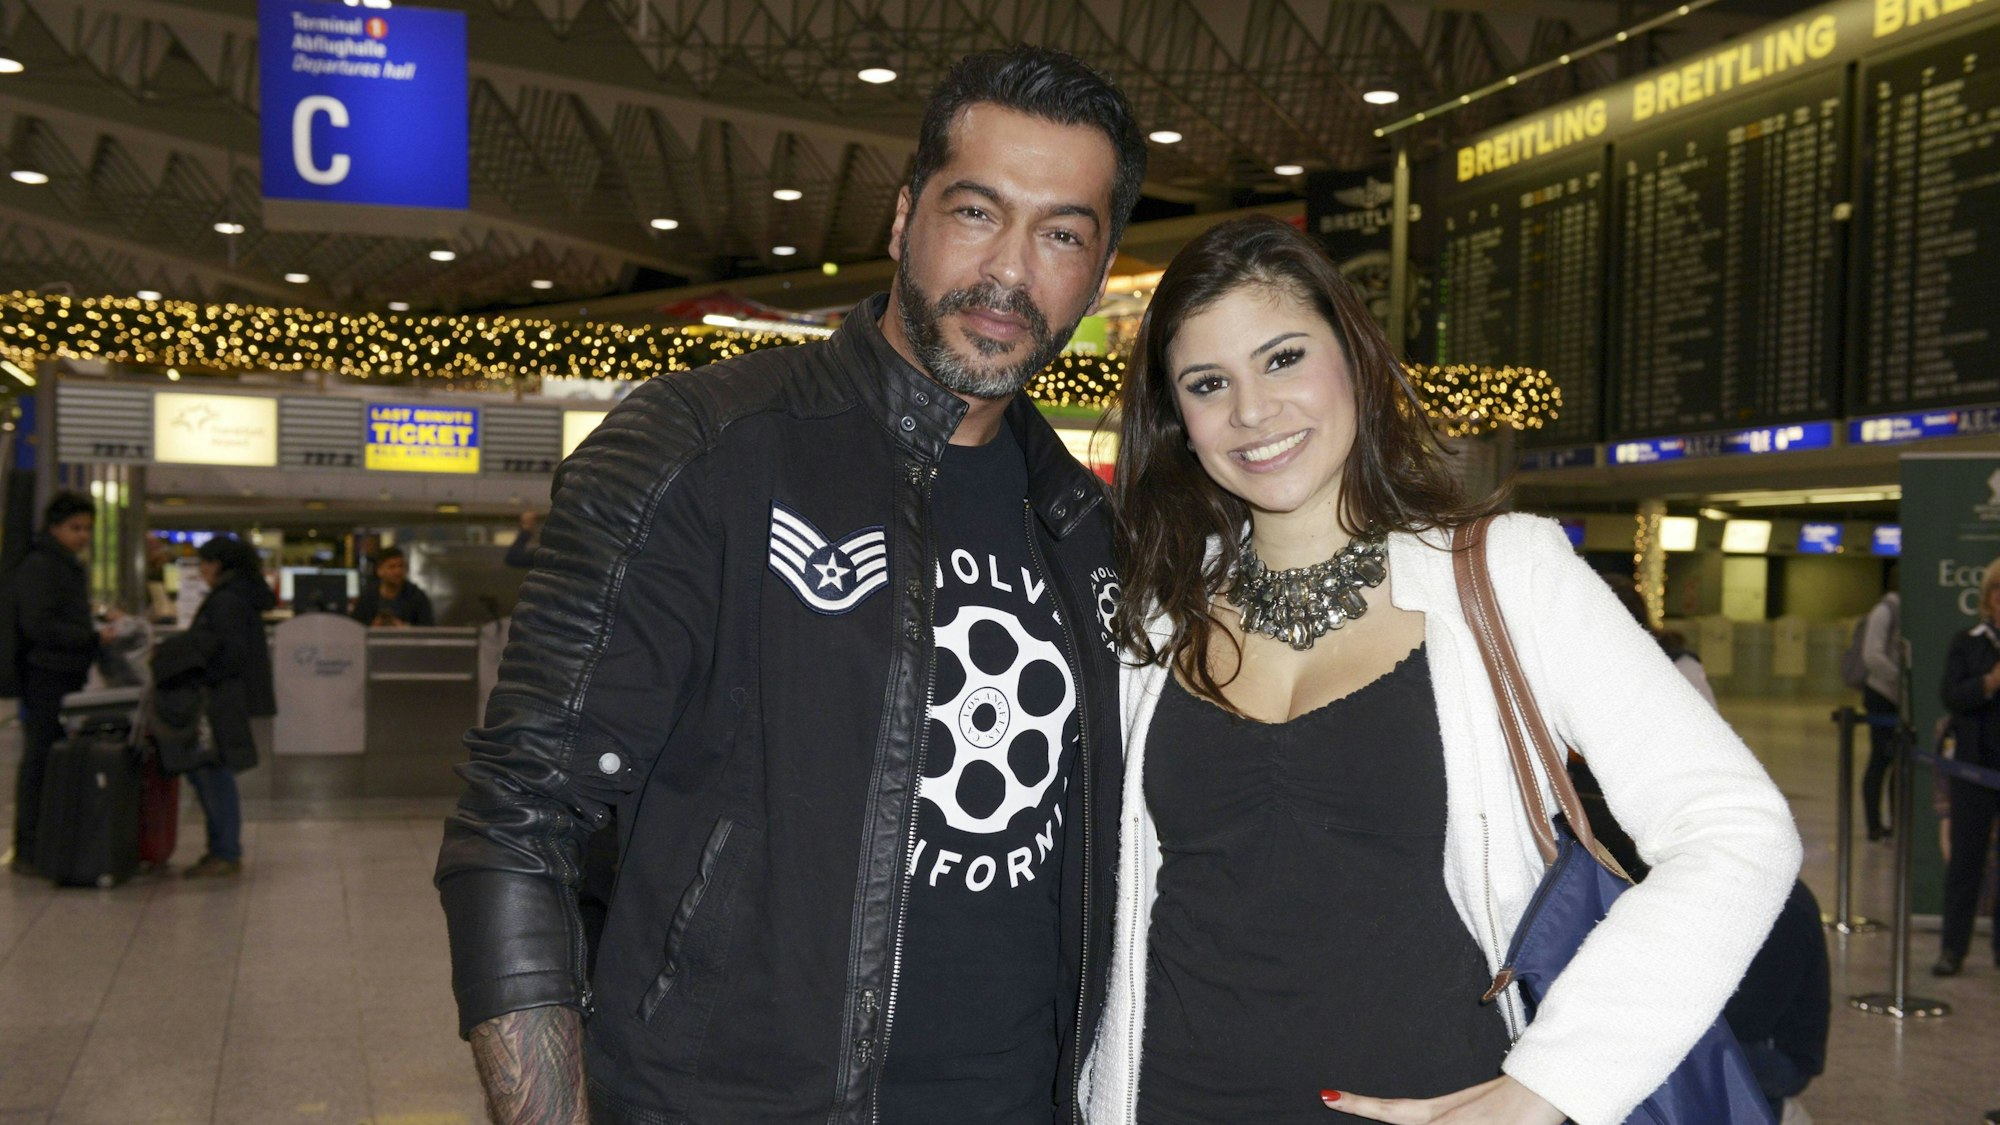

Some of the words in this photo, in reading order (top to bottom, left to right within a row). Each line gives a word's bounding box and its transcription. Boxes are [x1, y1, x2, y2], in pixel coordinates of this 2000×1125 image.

[291, 12, 363, 35] Terminal
[291, 33, 387, 59] Abflughalle
[291, 53, 382, 78] Departures
[382, 60, 416, 80] hall
[1632, 15, 1837, 121] BREITLING
[292, 95, 350, 186] C
[1457, 99, 1607, 182] BREITLING
[371, 408, 411, 421] LAST
[414, 409, 473, 425] MINUTE
[371, 422, 474, 446] TICKET
